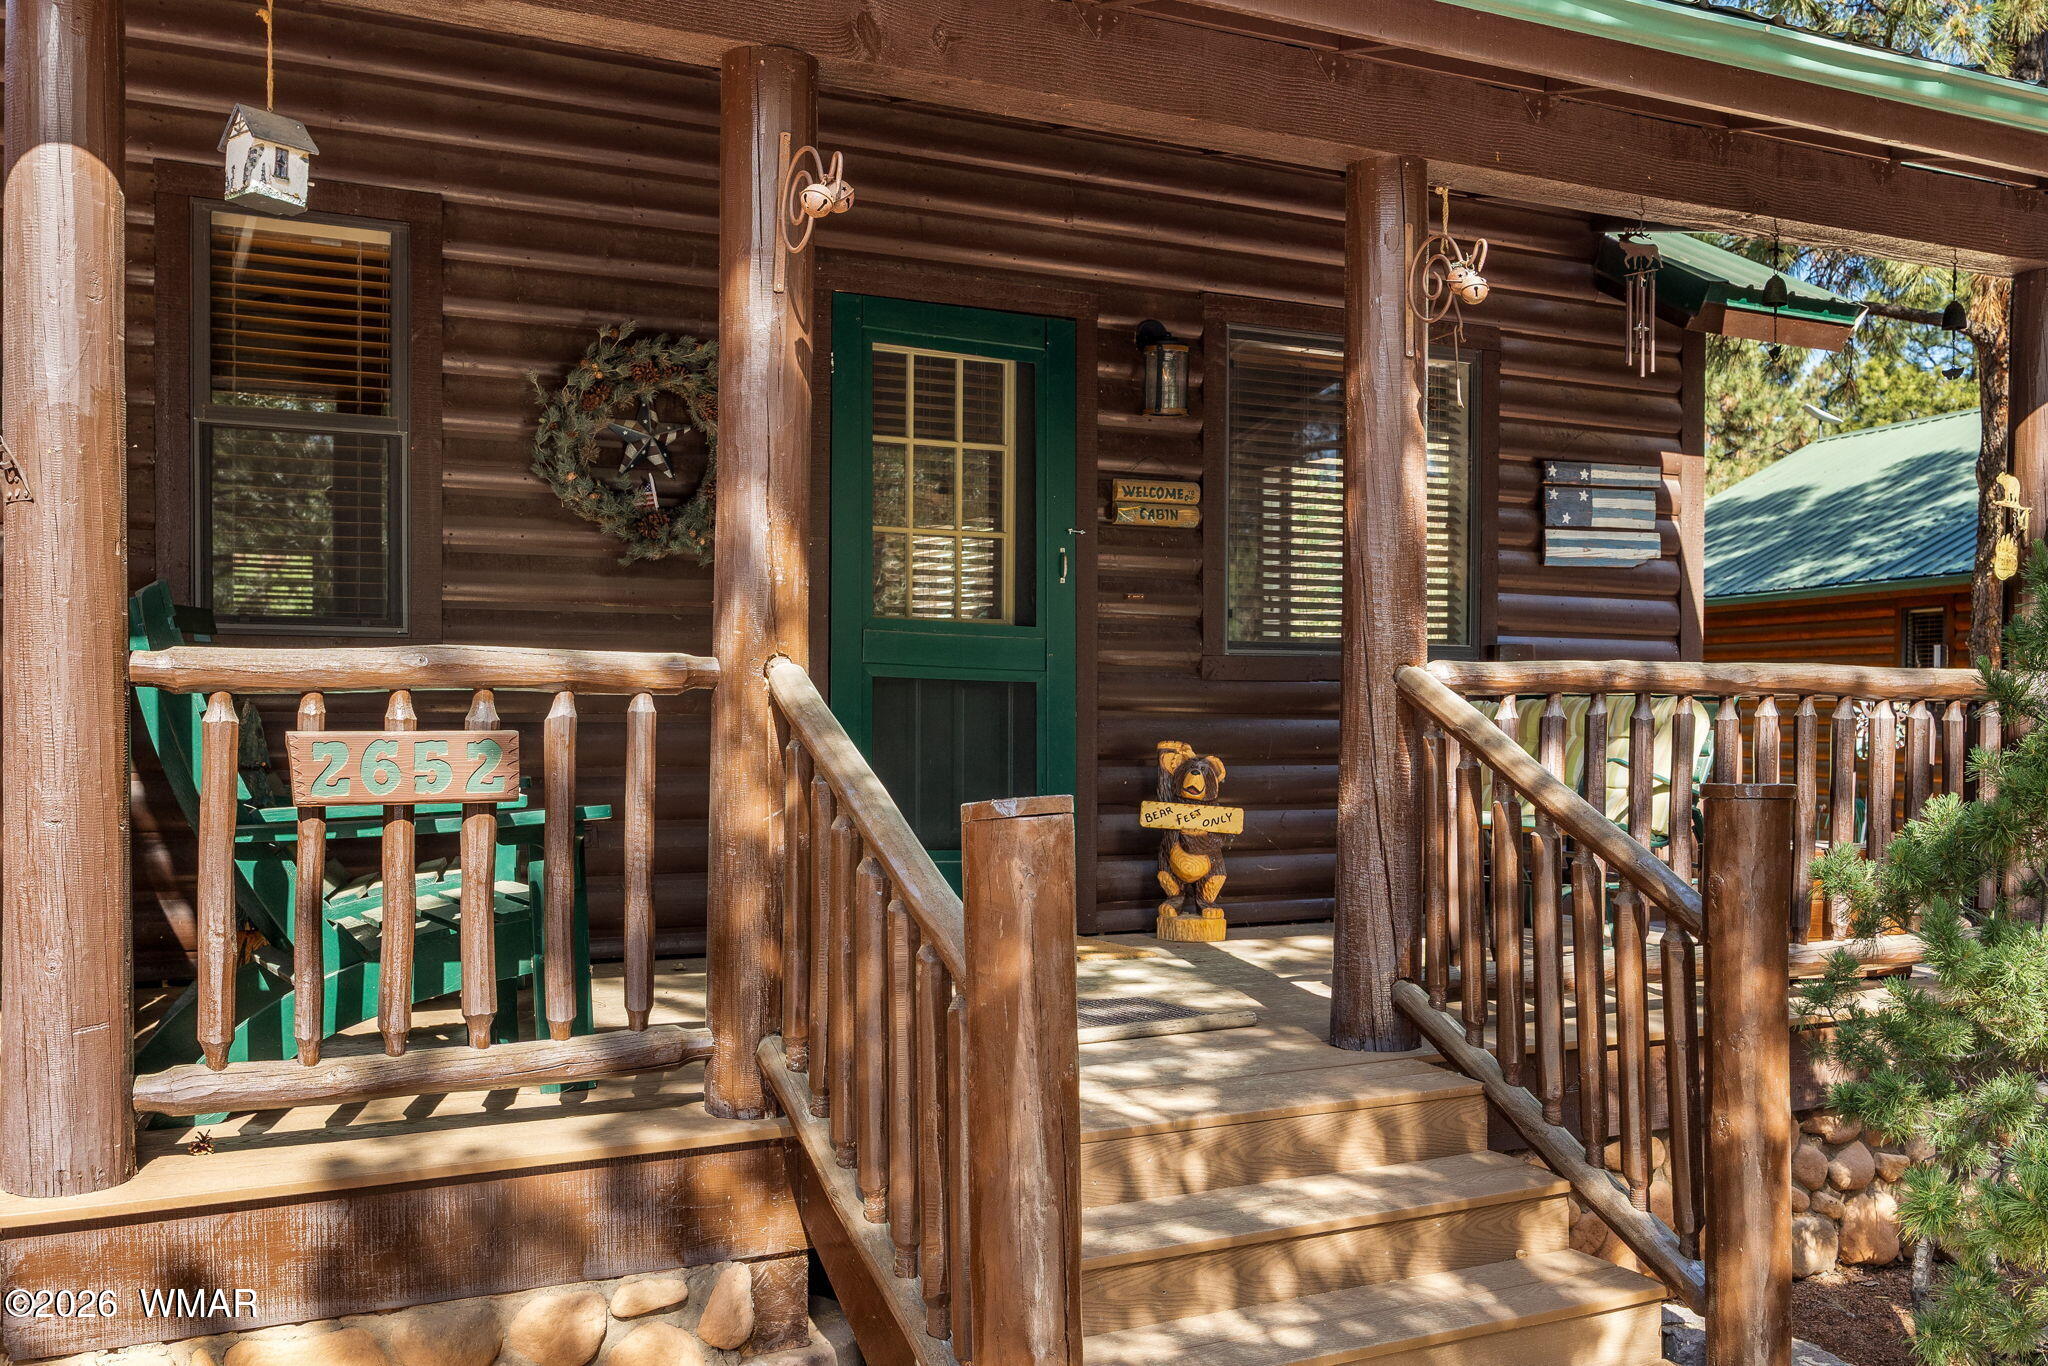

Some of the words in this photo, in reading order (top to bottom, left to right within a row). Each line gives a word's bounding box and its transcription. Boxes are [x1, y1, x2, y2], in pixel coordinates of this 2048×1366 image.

[1121, 485, 1182, 500] WELCOME
[1140, 507, 1179, 521] CABIN
[310, 738, 506, 797] 2652
[1145, 807, 1174, 823] BEAR
[1176, 808, 1202, 826] FEET
[1203, 812, 1233, 828] ONLY
